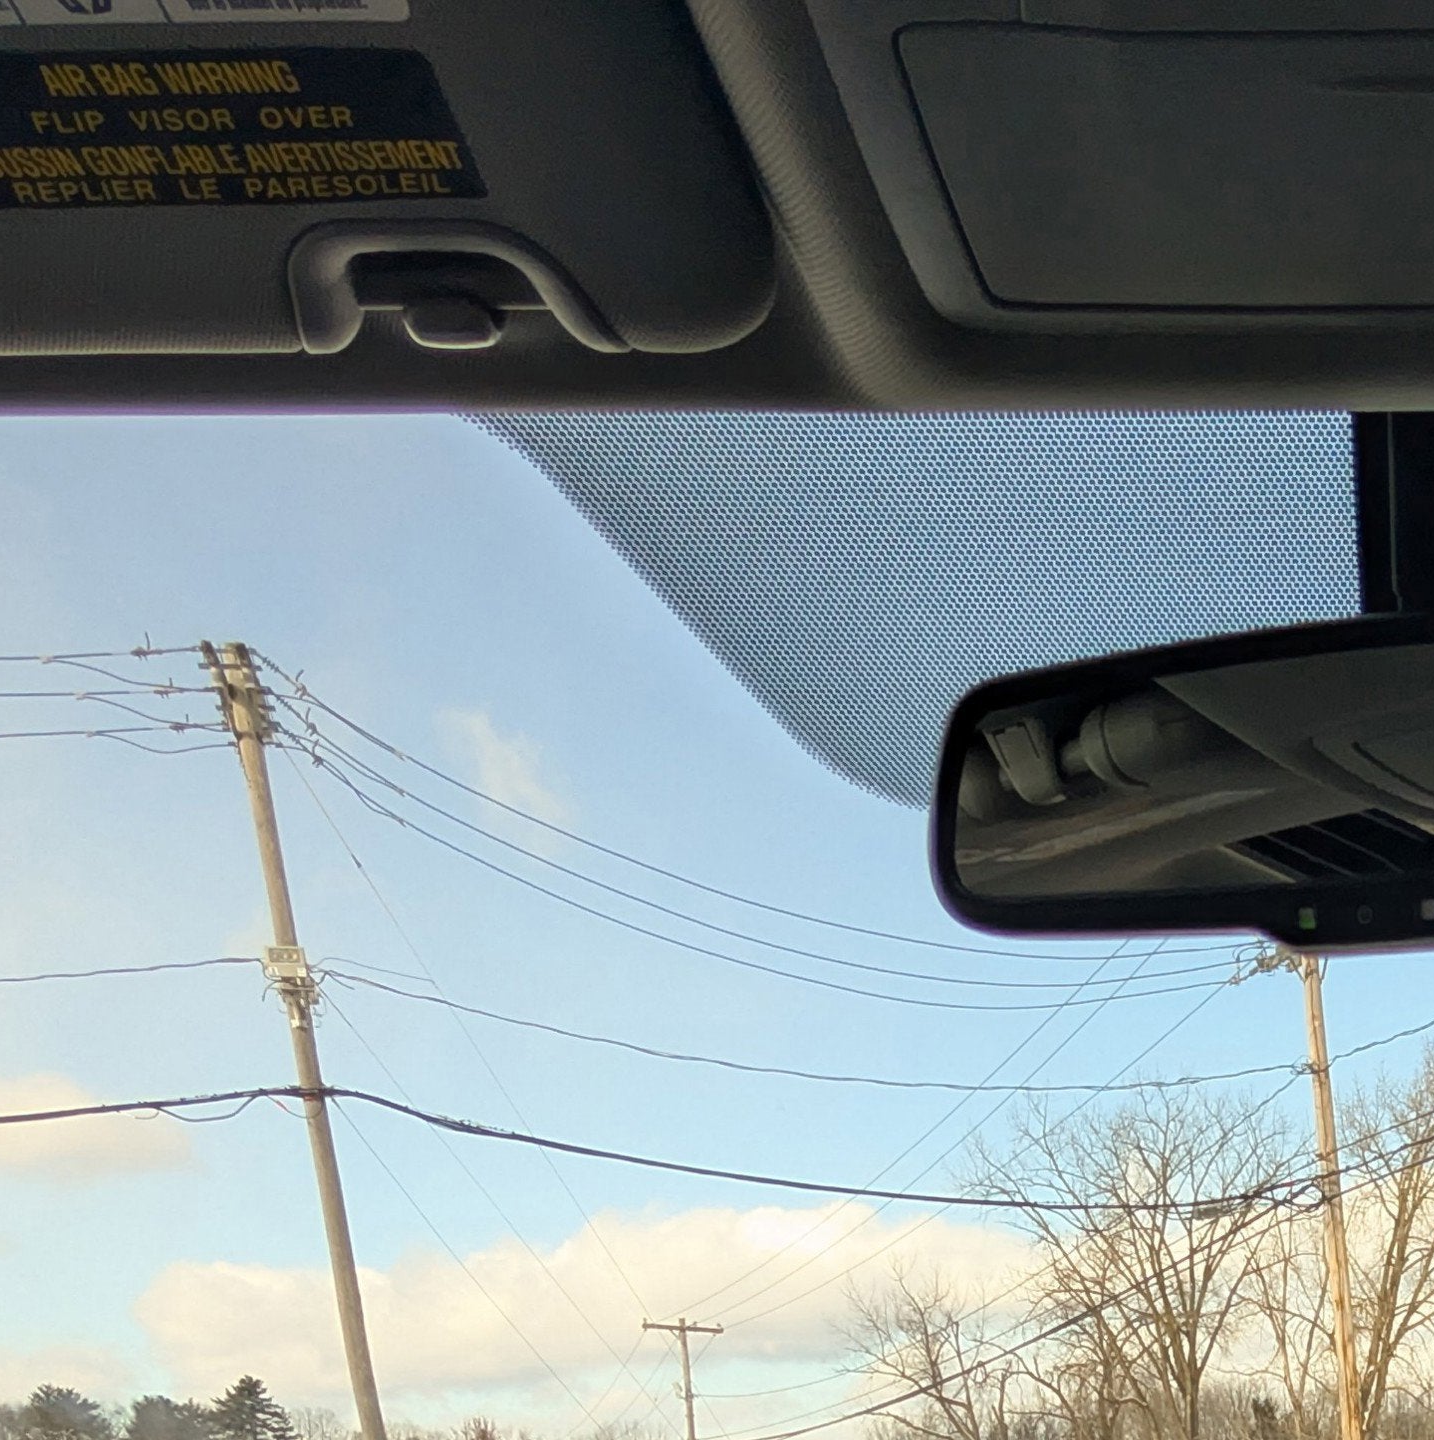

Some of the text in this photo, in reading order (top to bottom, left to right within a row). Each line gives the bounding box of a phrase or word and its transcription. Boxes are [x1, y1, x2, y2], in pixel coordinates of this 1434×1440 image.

[39, 59, 302, 97] AIR BAG WARNING
[32, 105, 354, 134] FLIP VISOR OVER
[81, 141, 246, 177] GONFLABLE
[245, 139, 463, 174] AVERTISSEMENT
[13, 171, 452, 205] REPLIER LE PARESOLEIL
